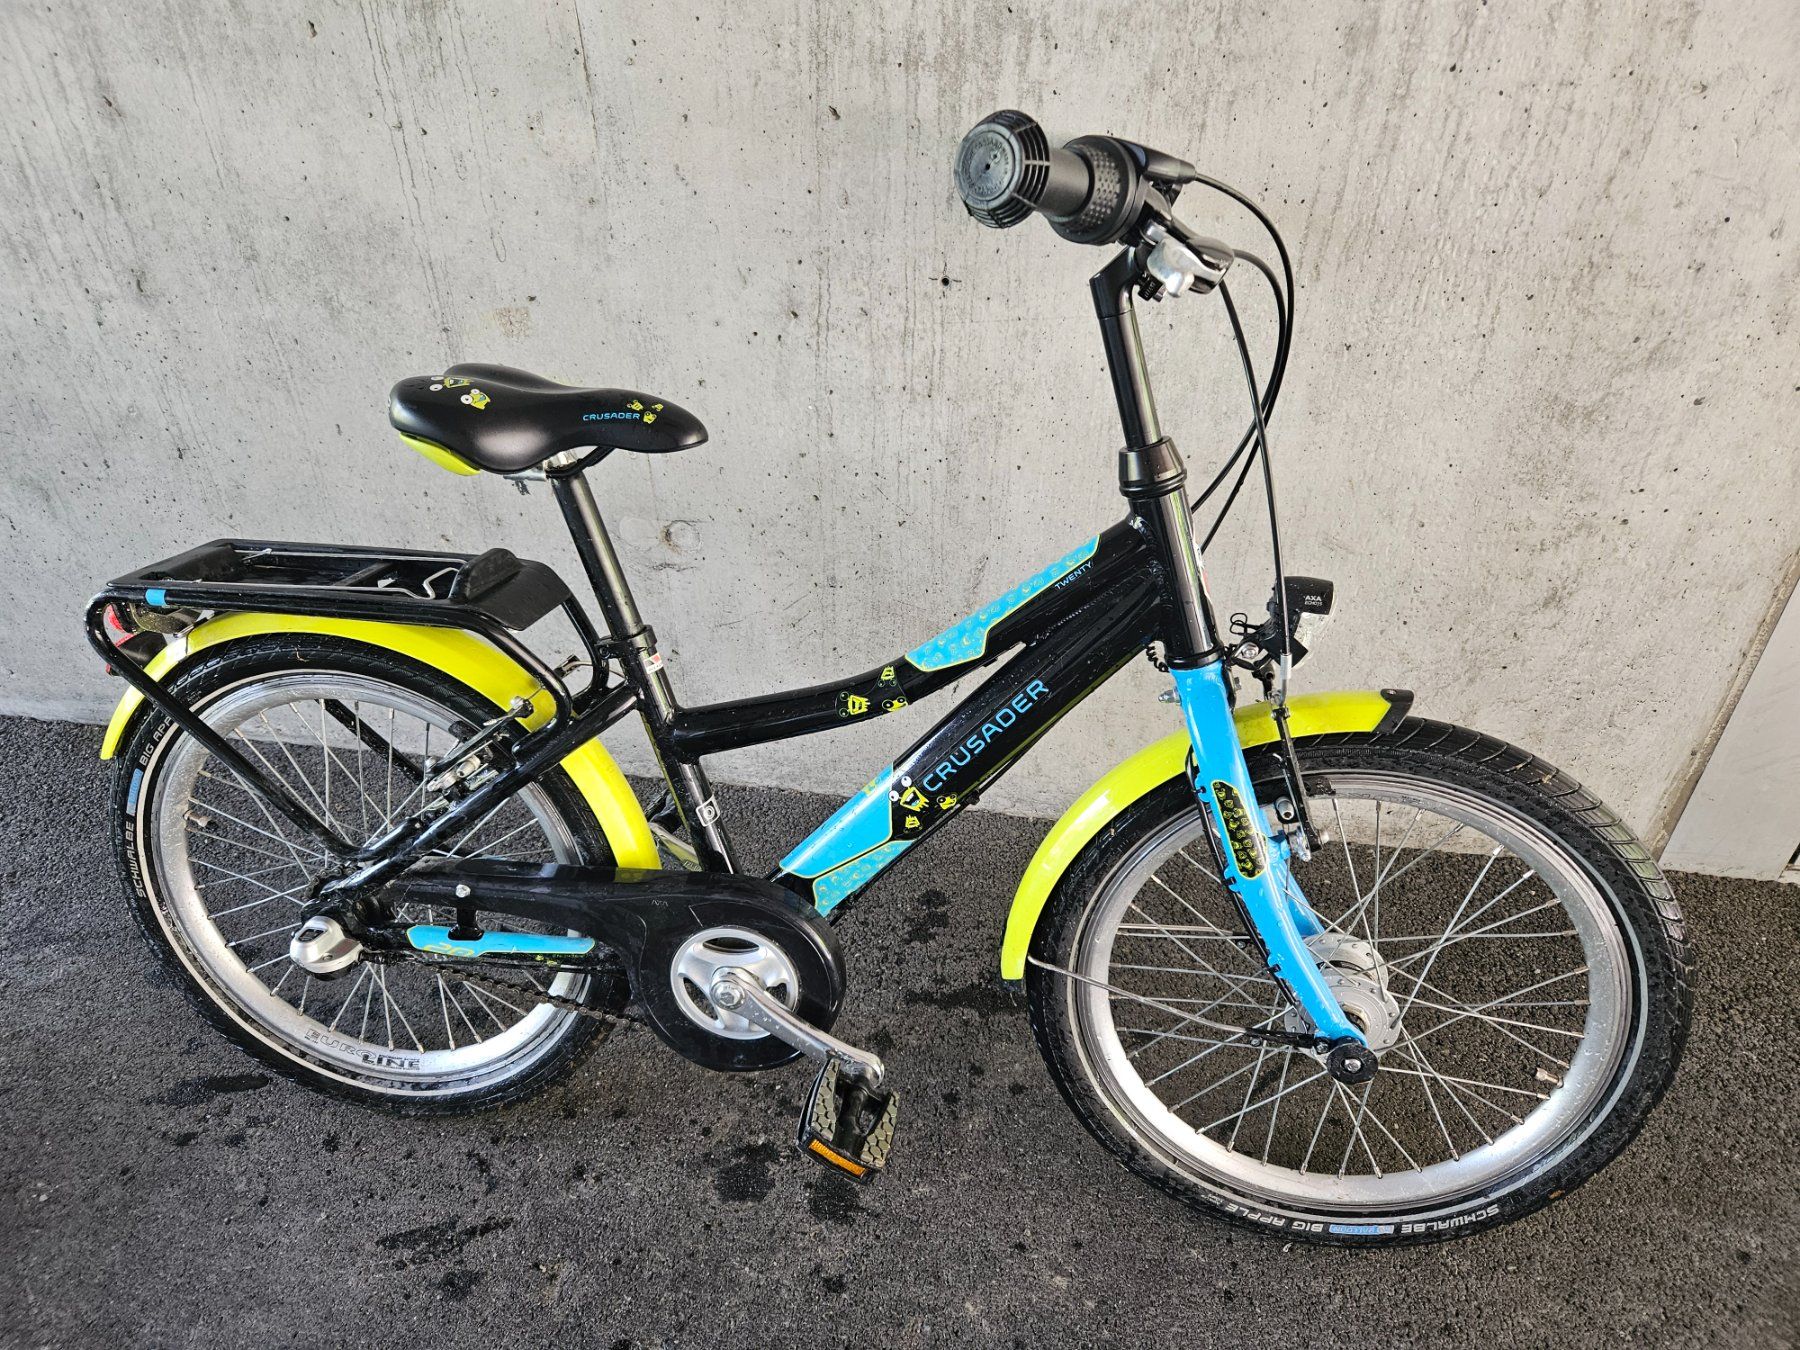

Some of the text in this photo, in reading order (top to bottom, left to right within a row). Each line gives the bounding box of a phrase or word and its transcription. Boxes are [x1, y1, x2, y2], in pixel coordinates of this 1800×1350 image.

[583, 412, 640, 421] CRUSADER
[1054, 560, 1093, 590] TWENTY
[923, 679, 1050, 792] CRUSADER
[125, 820, 147, 898] SCHWALBE
[139, 743, 154, 767] BIG
[153, 715, 172, 742] APP
[1225, 1203, 1284, 1227] APPLE
[1291, 1221, 1324, 1233] BIG
[1401, 1203, 1499, 1234] SCHWALBE
